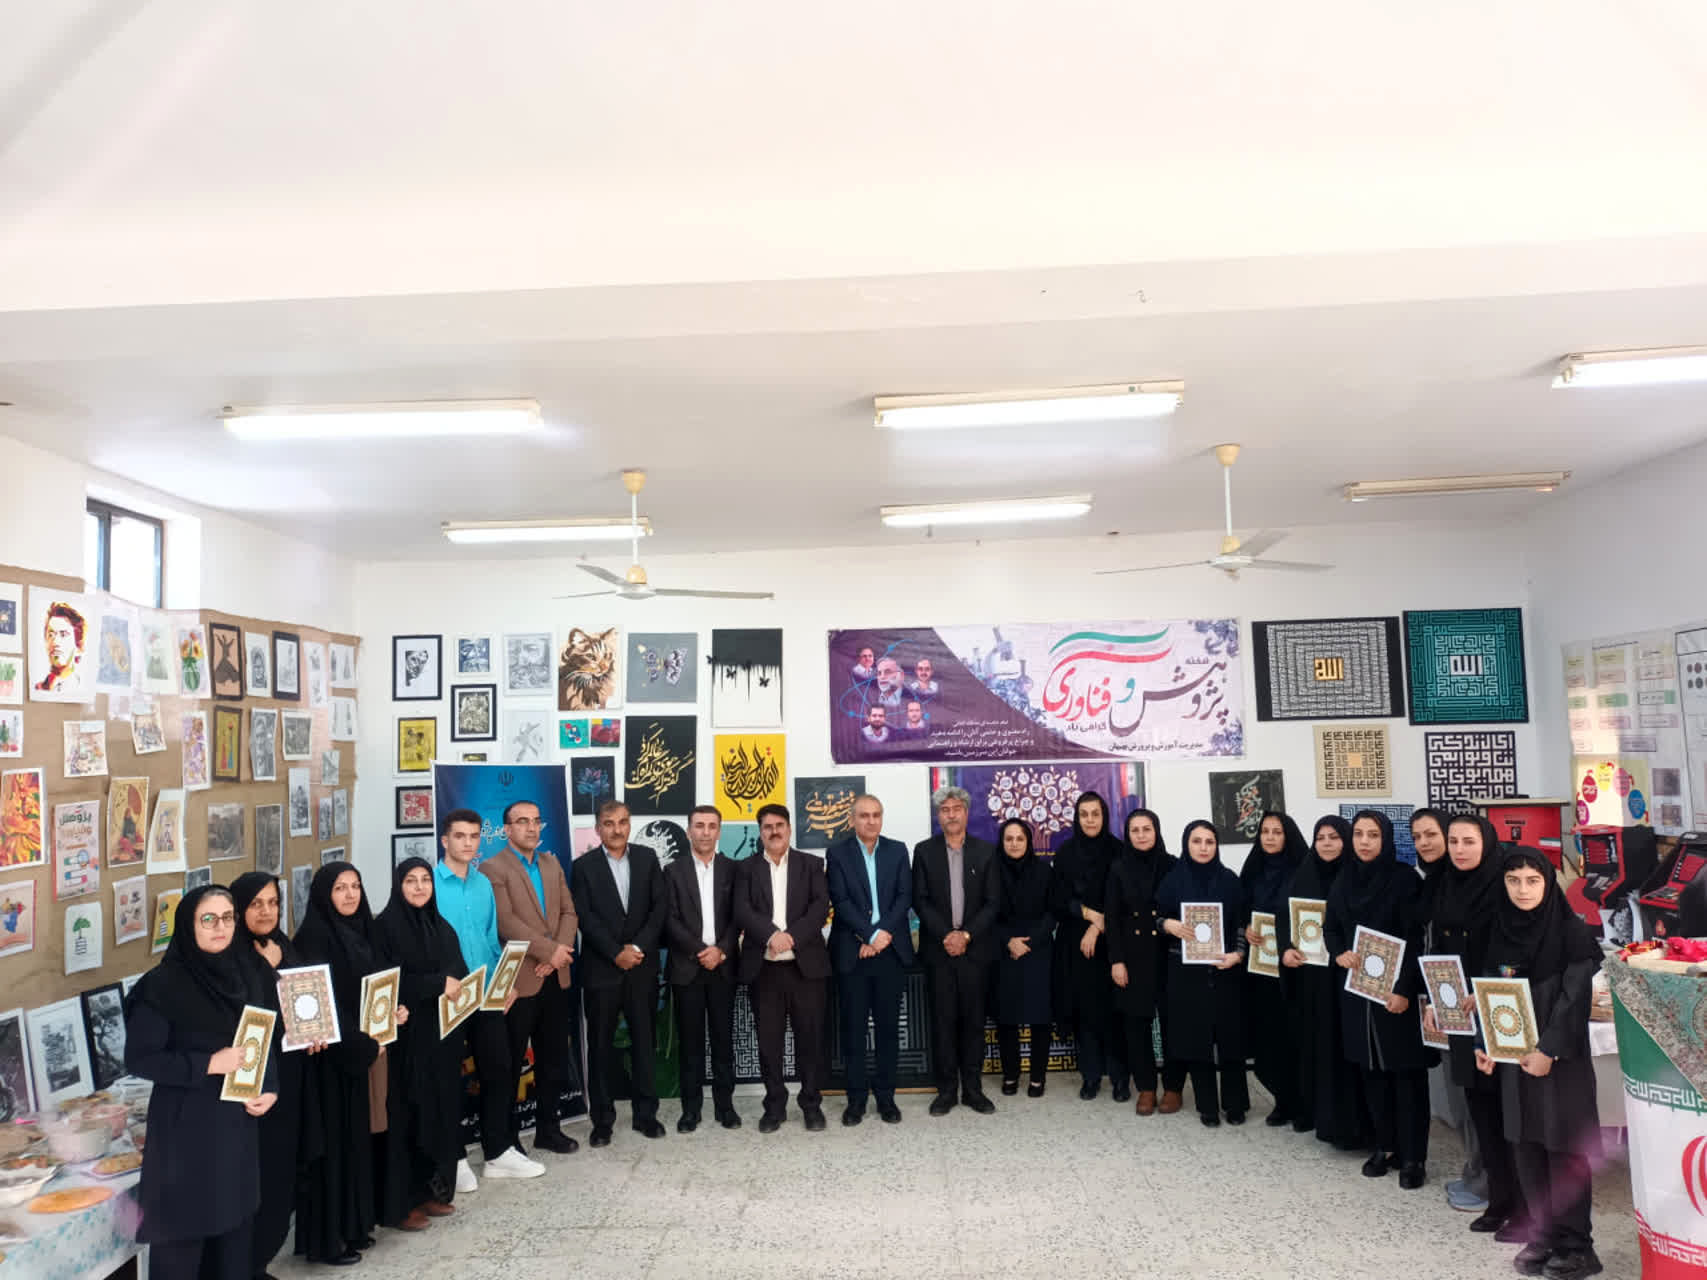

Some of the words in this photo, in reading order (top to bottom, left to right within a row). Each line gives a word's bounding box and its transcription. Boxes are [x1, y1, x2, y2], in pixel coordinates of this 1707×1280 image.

[1184, 656, 1209, 665] هفته
[1042, 666, 1112, 722] فناوری
[1108, 661, 1230, 738] پژوهش
[1115, 677, 1136, 704] و
[1080, 721, 1107, 733] گرامی
